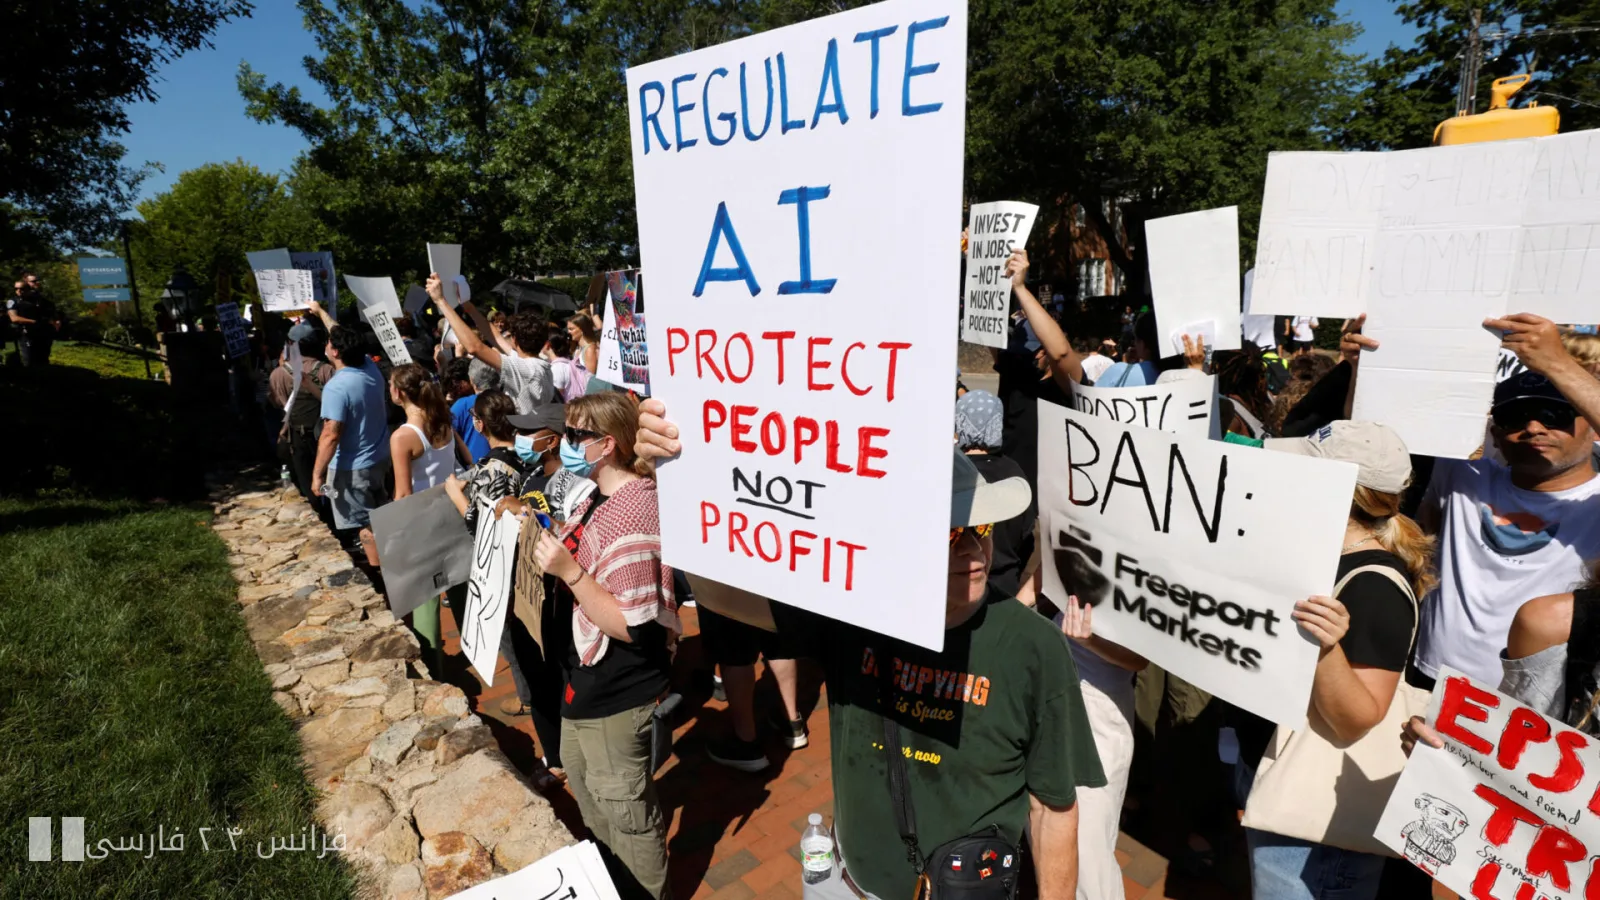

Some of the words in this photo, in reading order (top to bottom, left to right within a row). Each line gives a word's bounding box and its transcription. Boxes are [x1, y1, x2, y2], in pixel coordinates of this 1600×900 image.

[639, 15, 950, 155] REGULATE
[692, 184, 838, 298] AI
[972, 241, 982, 259] IN
[984, 239, 1016, 259] JOBS
[974, 213, 1026, 235] INVEST
[969, 315, 1004, 335] POCKETS
[970, 290, 1005, 311] MUSK'S
[608, 356, 618, 371] is
[621, 327, 646, 343] what
[666, 327, 912, 403] PROTECT
[702, 399, 891, 479] PEOPLE
[732, 466, 826, 509] NOT
[1065, 418, 1253, 543] BAN:
[700, 500, 868, 591] PROFIT
[1114, 551, 1281, 638] Freeport
[1112, 588, 1265, 673] Markets
[911, 700, 955, 723] Space
[914, 749, 942, 765] now
[1435, 675, 1600, 818] EPS
[1443, 741, 1496, 780] neighbor
[1509, 783, 1529, 800] and
